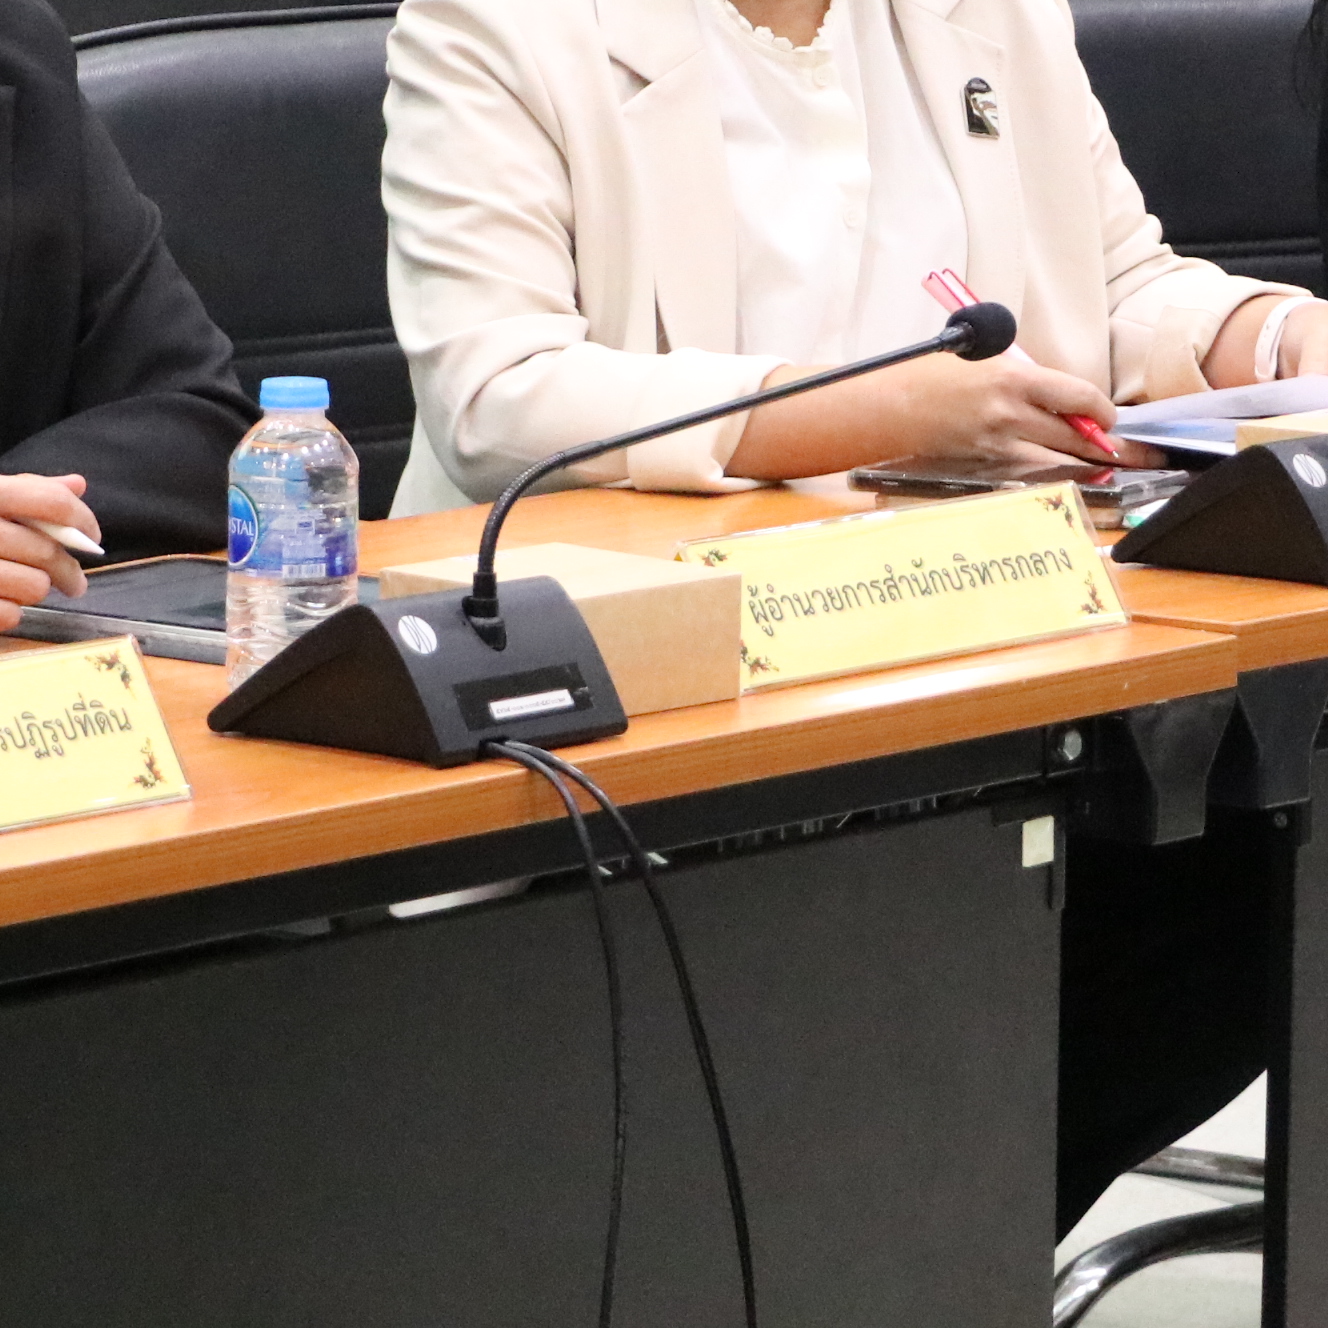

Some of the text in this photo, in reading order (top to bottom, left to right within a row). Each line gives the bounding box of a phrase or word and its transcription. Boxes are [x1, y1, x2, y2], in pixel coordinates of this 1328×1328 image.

[229, 517, 255, 537] STAL
[746, 545, 1074, 638] ผู้อำนวยการสำนักบริหารกลาง
